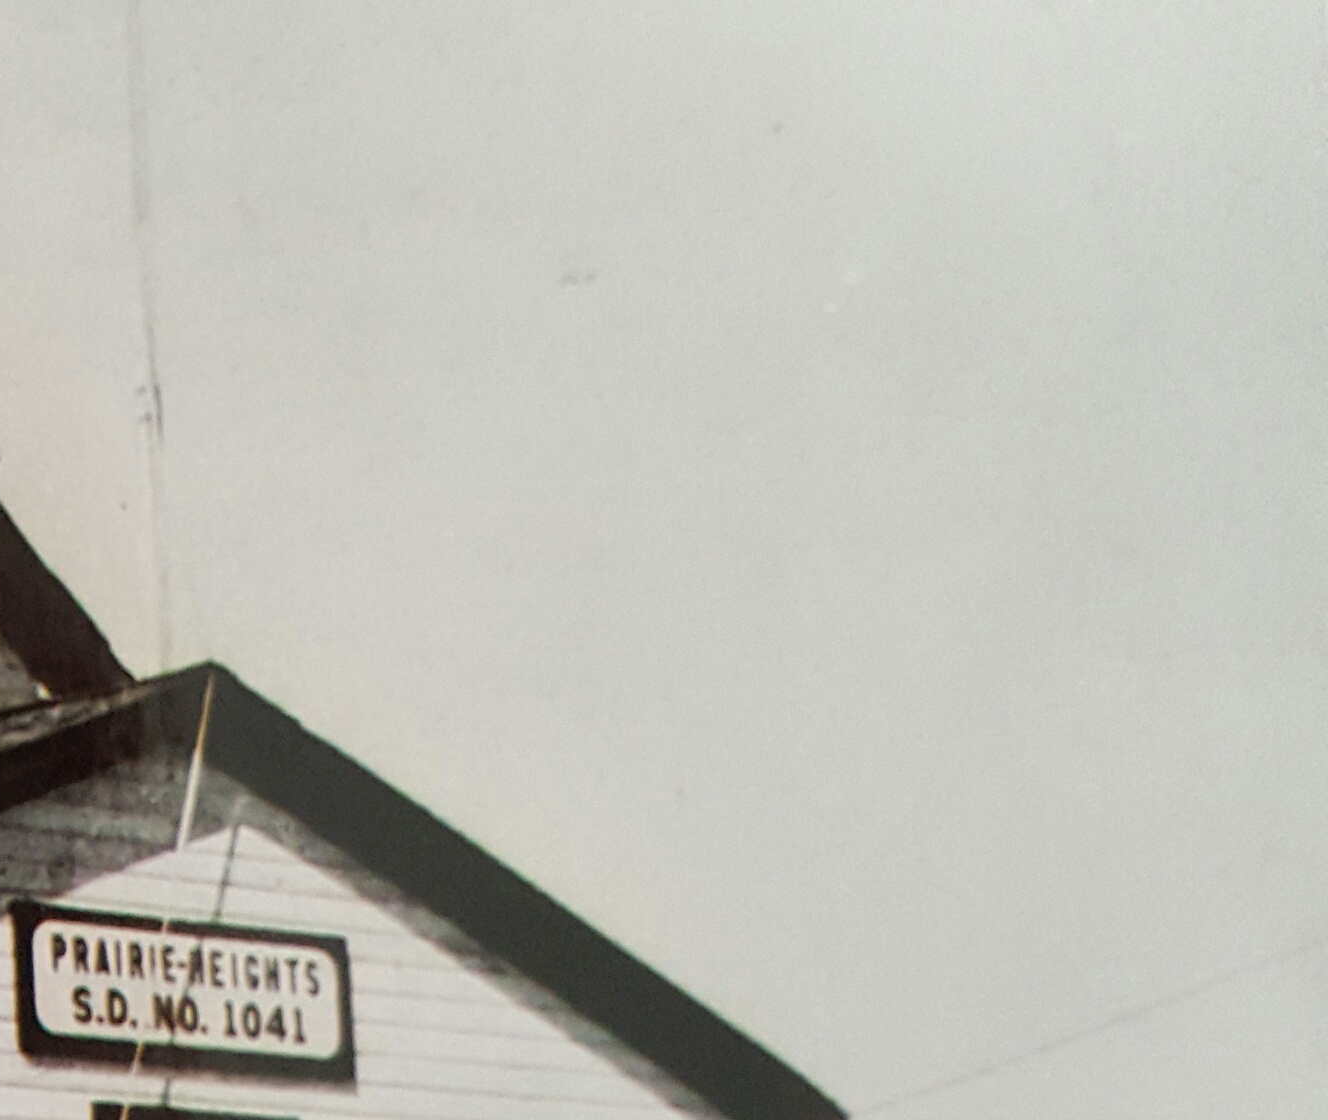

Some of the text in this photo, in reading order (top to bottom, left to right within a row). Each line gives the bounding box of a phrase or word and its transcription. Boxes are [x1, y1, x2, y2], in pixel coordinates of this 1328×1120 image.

[72, 985, 306, 1044] S.D. NO. 1041
